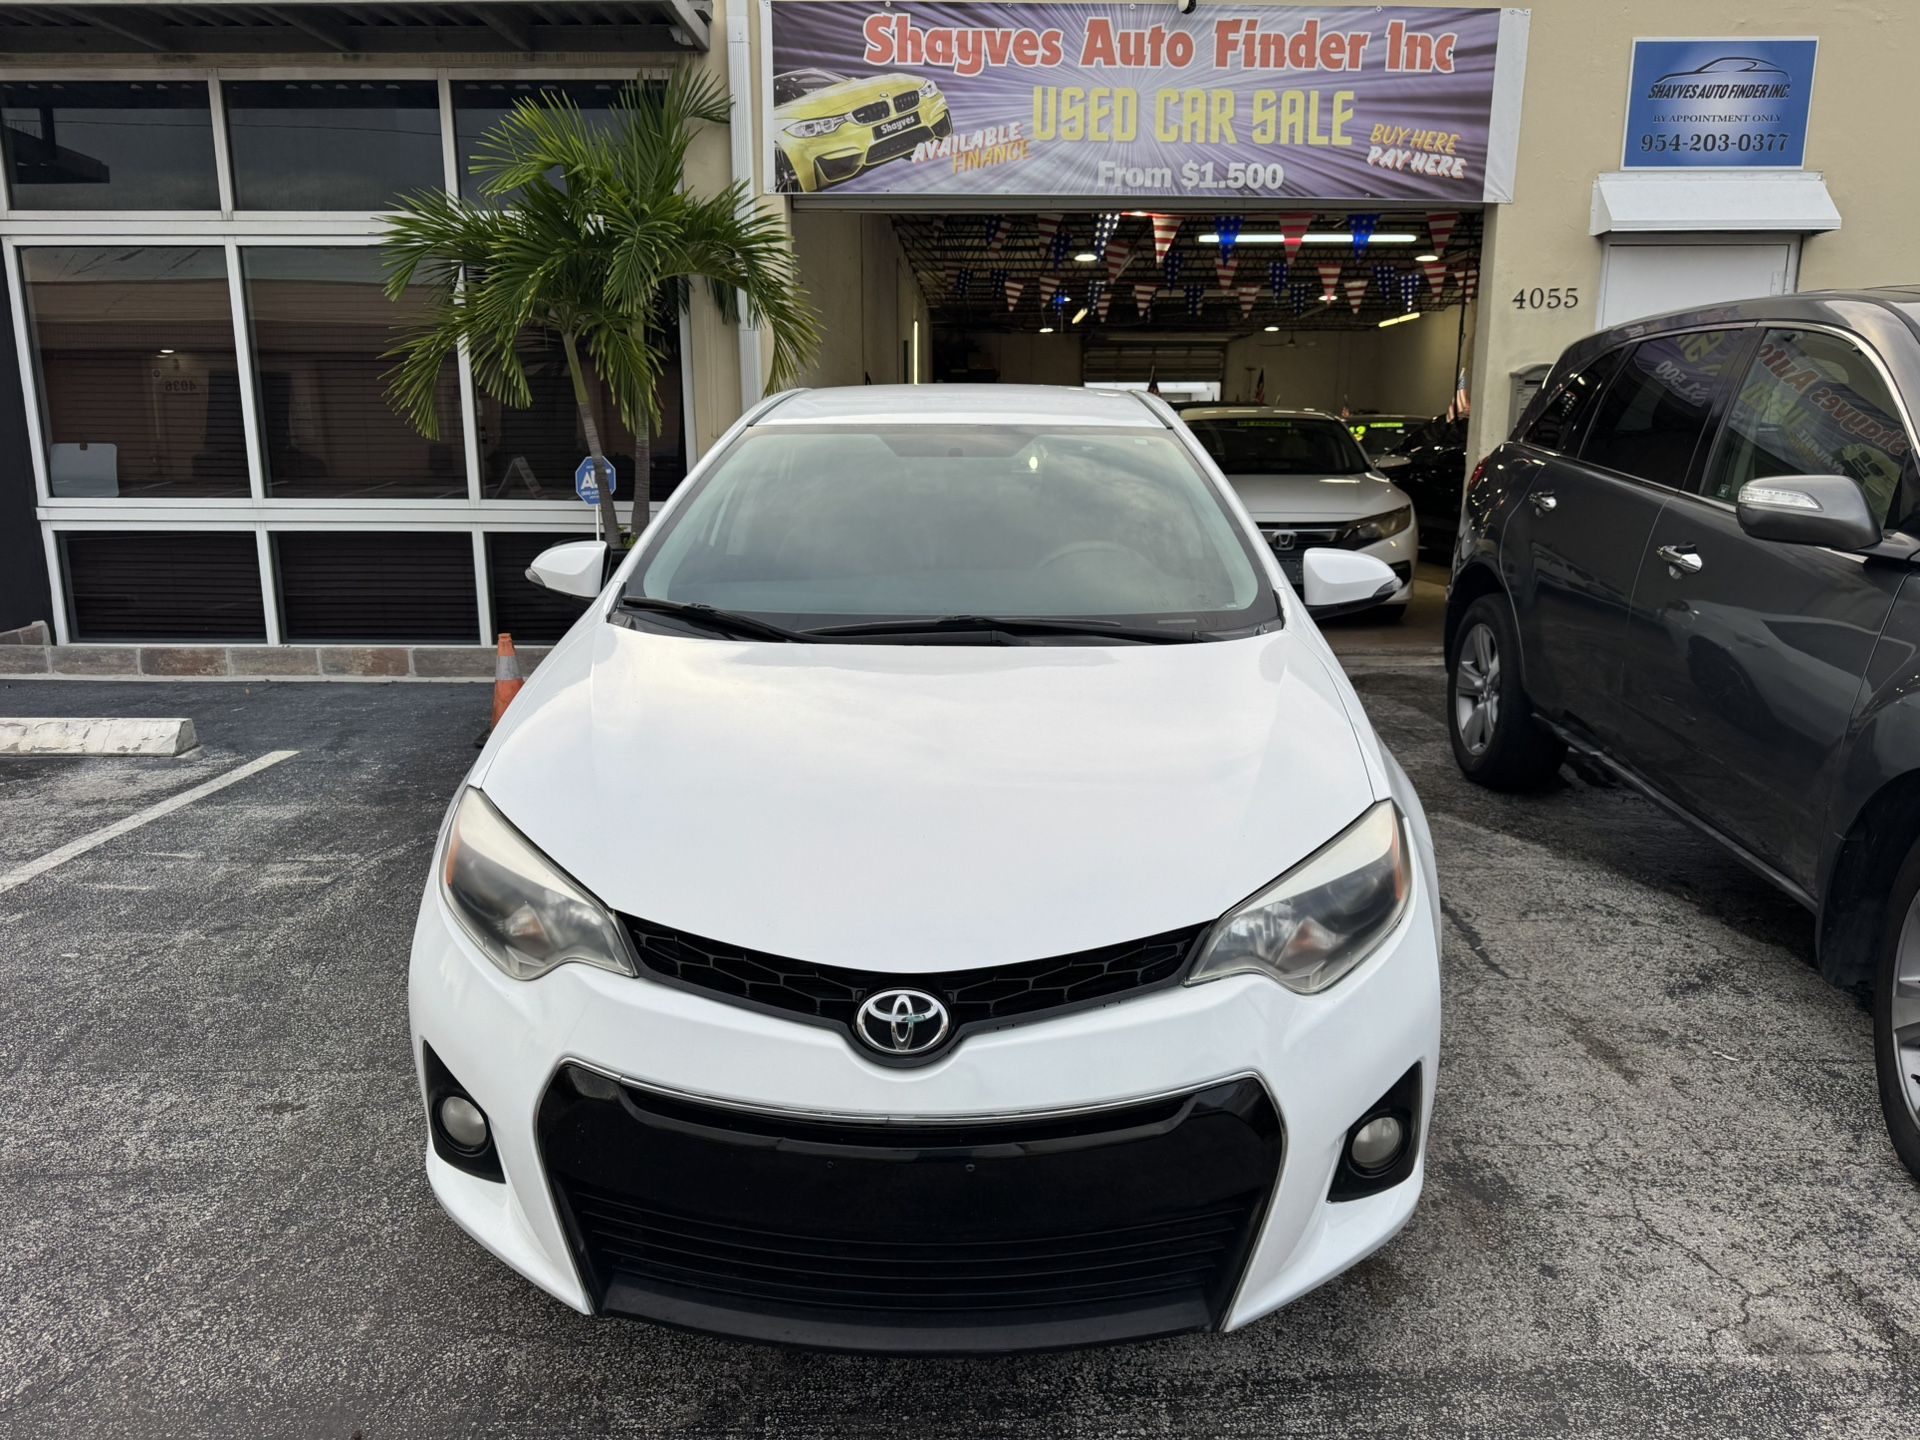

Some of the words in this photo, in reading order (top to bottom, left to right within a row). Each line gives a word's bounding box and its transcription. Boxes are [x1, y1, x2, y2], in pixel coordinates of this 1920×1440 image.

[863, 12, 1064, 77] Shayves
[1079, 16, 1196, 69] Auto
[1213, 17, 1371, 71] Finder
[1385, 19, 1458, 74] Inc
[1648, 84, 1701, 99] SHAYVES
[1699, 84, 1731, 99] AUTO
[1730, 84, 1769, 99] FINDER
[880, 114, 915, 135] Shayves
[1032, 85, 1139, 142] USED
[1155, 88, 1237, 144] CAR
[1252, 89, 1355, 146] SALE
[1653, 115, 1666, 123] BY
[1669, 114, 1751, 123] APPOINTMENT
[1752, 114, 1782, 122] ONLY
[911, 122, 1023, 163] AVAILABLE
[1369, 123, 1410, 146] BUY
[1408, 127, 1460, 155] HERE
[1641, 133, 1789, 152] 954-203-0377
[952, 139, 1032, 175] FINANCE
[1366, 146, 1411, 170] PAY
[1408, 153, 1468, 180] HERE
[1098, 161, 1171, 188] From
[1180, 160, 1284, 191] $1.500
[1512, 287, 1578, 309] 4055
